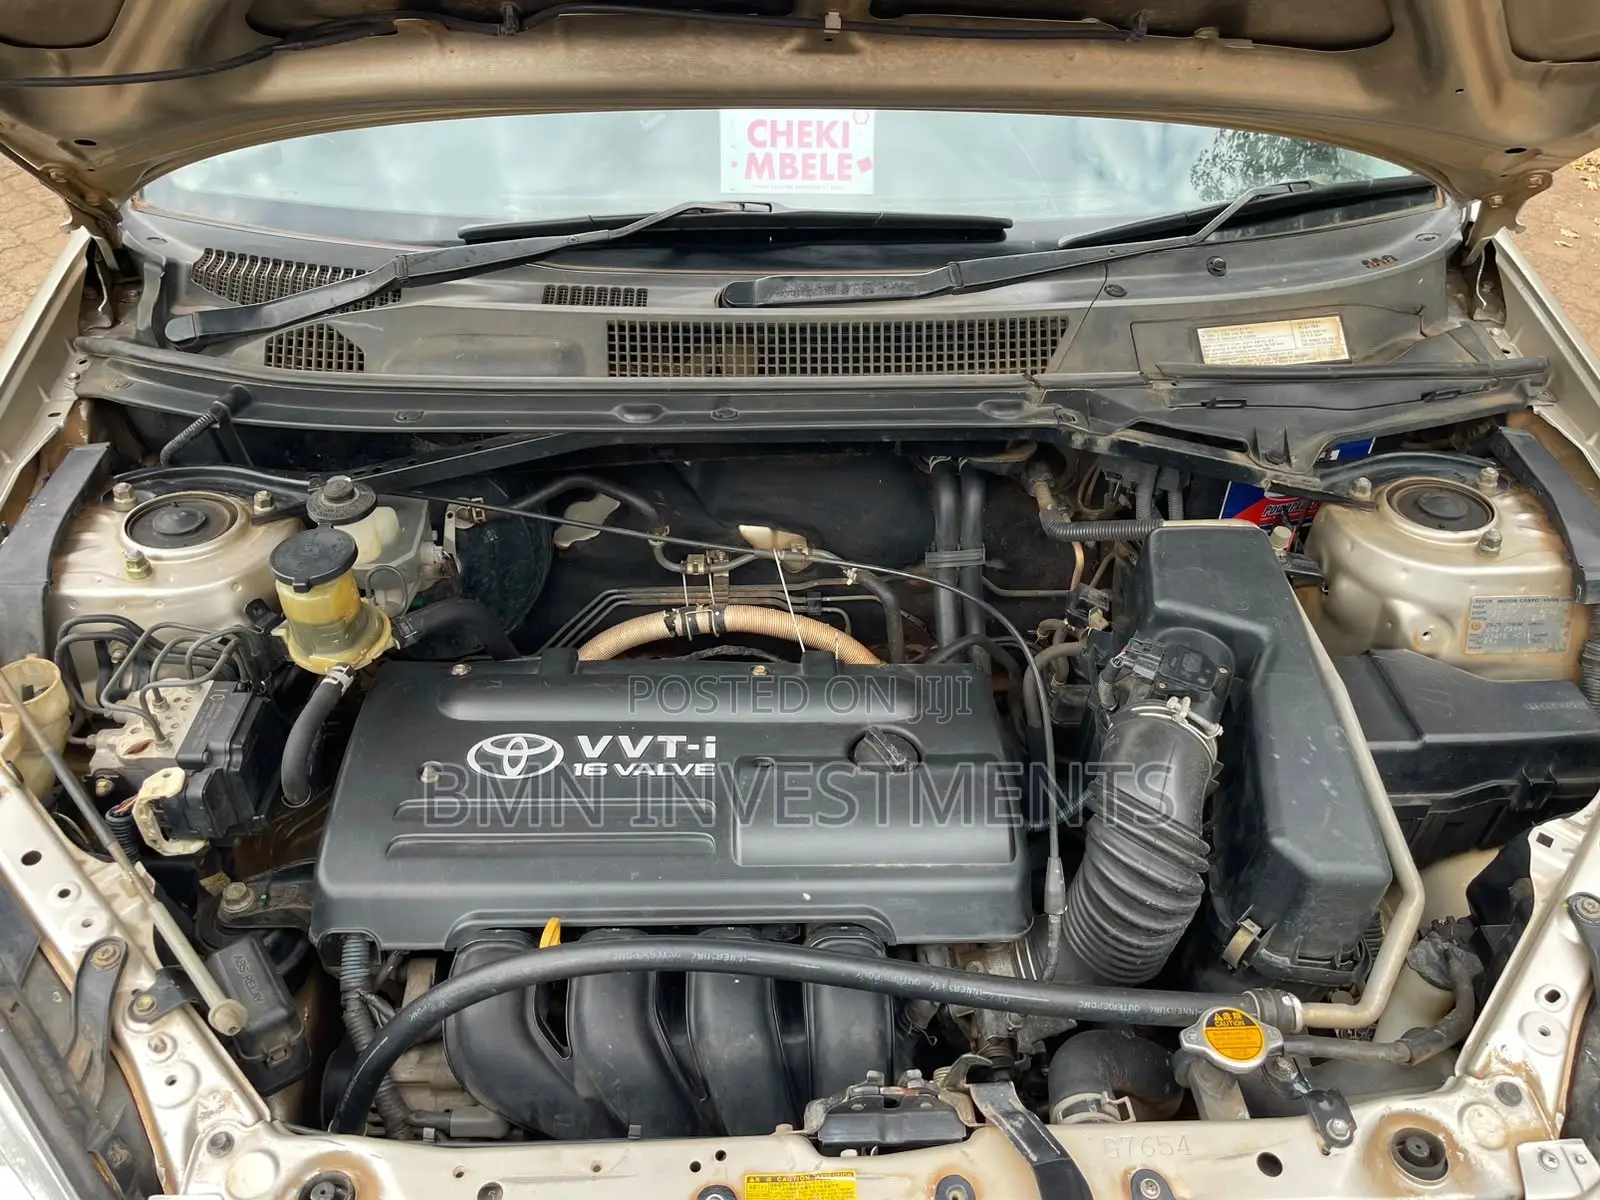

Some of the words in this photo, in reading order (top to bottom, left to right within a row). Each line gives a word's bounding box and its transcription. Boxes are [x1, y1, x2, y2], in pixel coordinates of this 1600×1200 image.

[747, 119, 850, 149] CHEKI
[744, 152, 853, 181] MBELE
[577, 735, 717, 759] VVT-i
[573, 763, 608, 777] 16
[614, 763, 716, 777] VALVE
[232, 954, 249, 974] ABS
[243, 973, 265, 1003] RELAY
[1214, 1019, 1246, 1028] CAUTION
[776, 1174, 810, 1183] CAUTION
